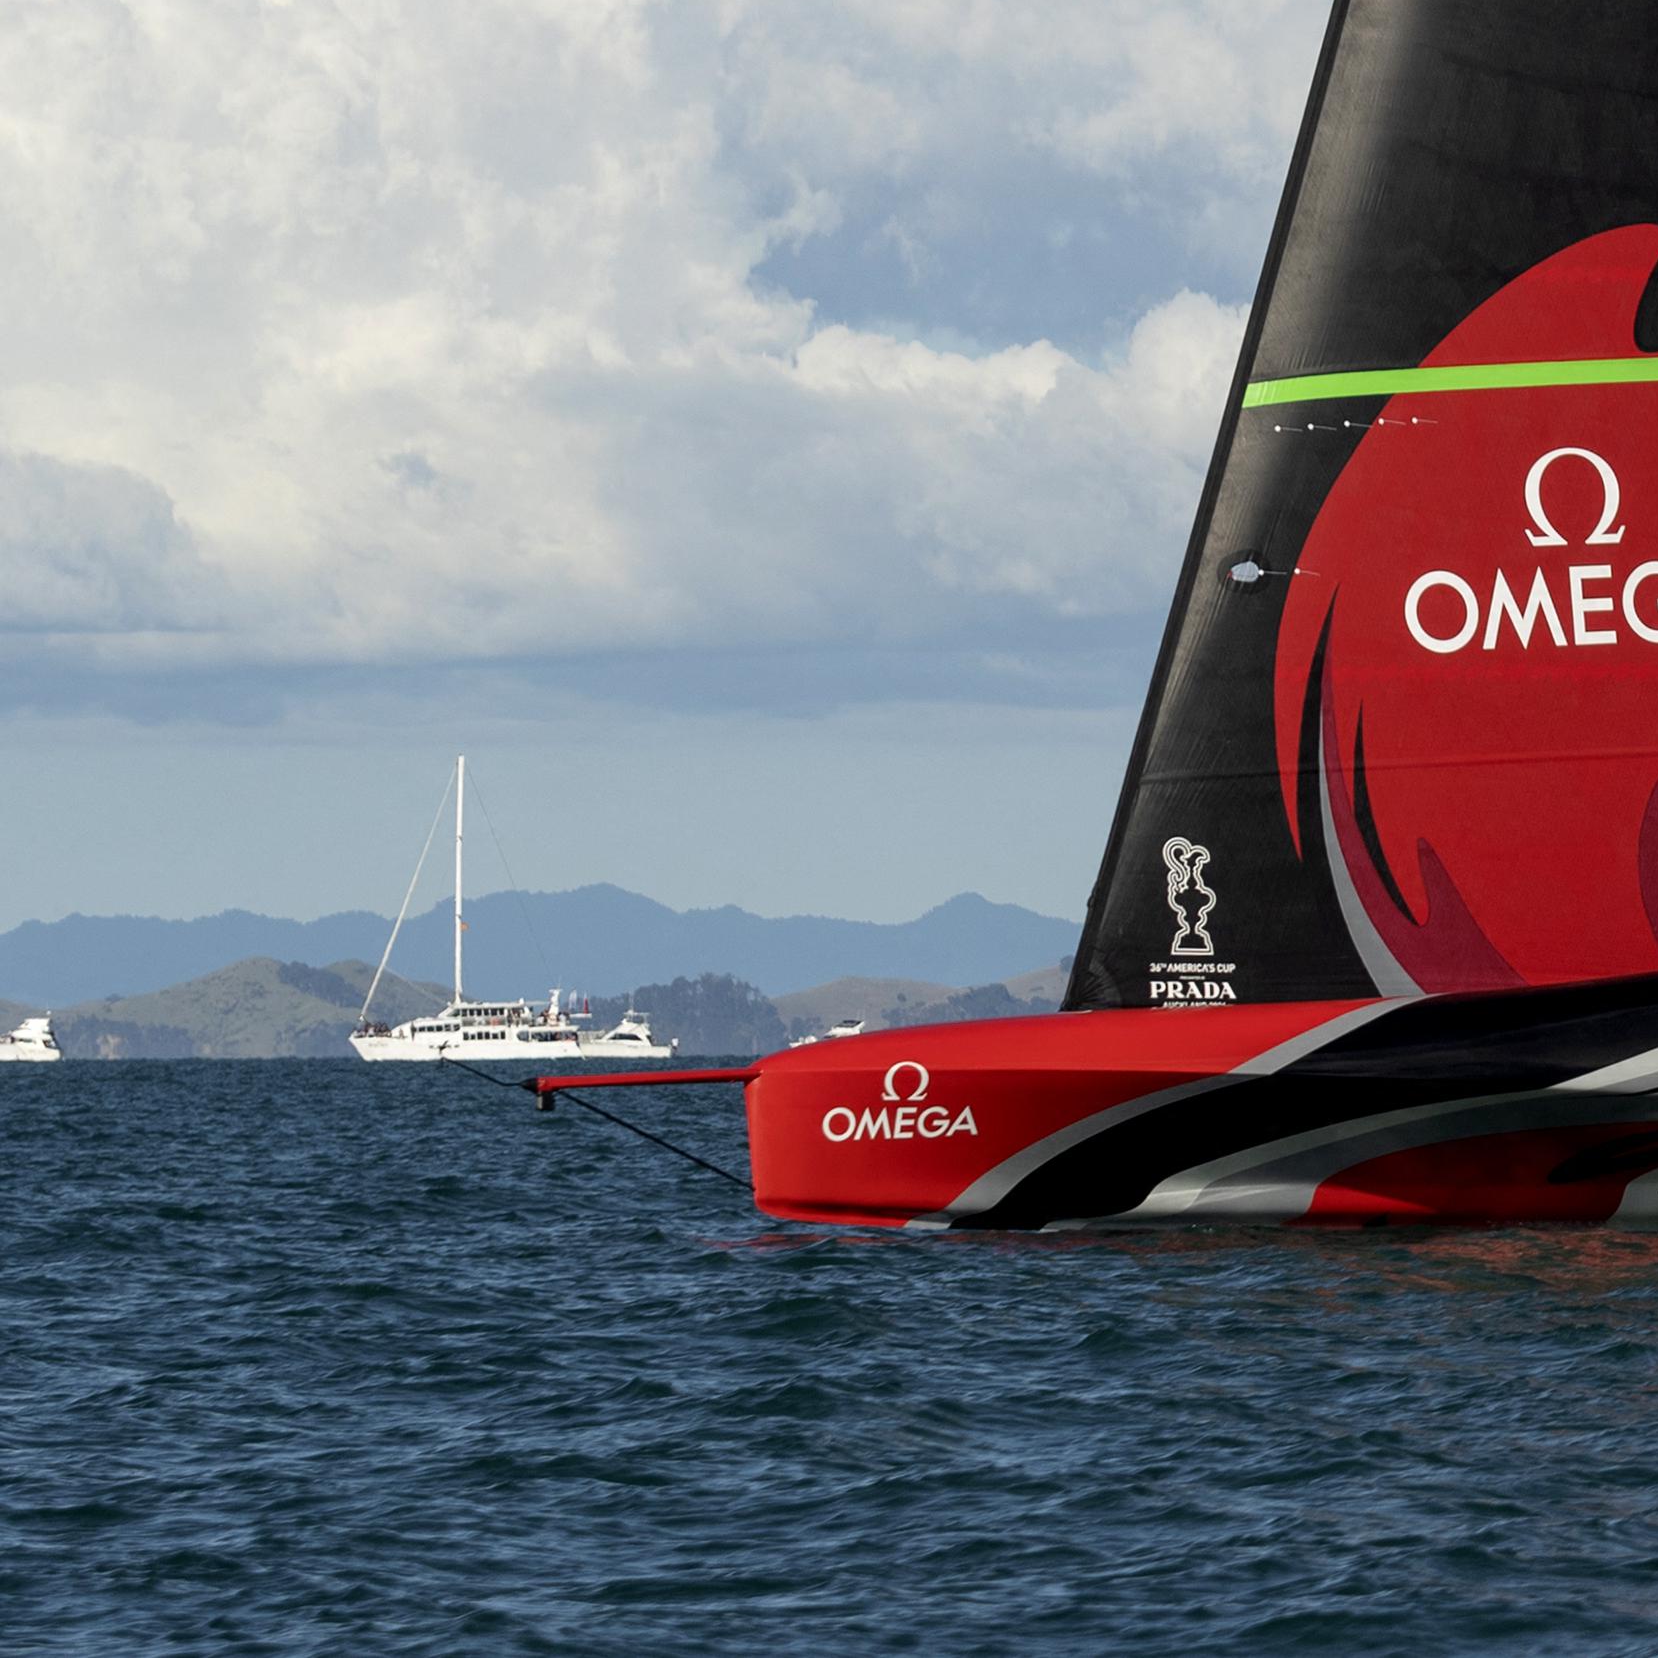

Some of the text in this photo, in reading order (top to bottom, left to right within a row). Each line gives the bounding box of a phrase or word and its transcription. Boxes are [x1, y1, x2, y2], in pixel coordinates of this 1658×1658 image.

[1166, 963, 1216, 973] AMERICA'S
[1216, 963, 1237, 973] CUP
[1149, 980, 1238, 1000] PRADA
[822, 1105, 979, 1143] OMEGA
